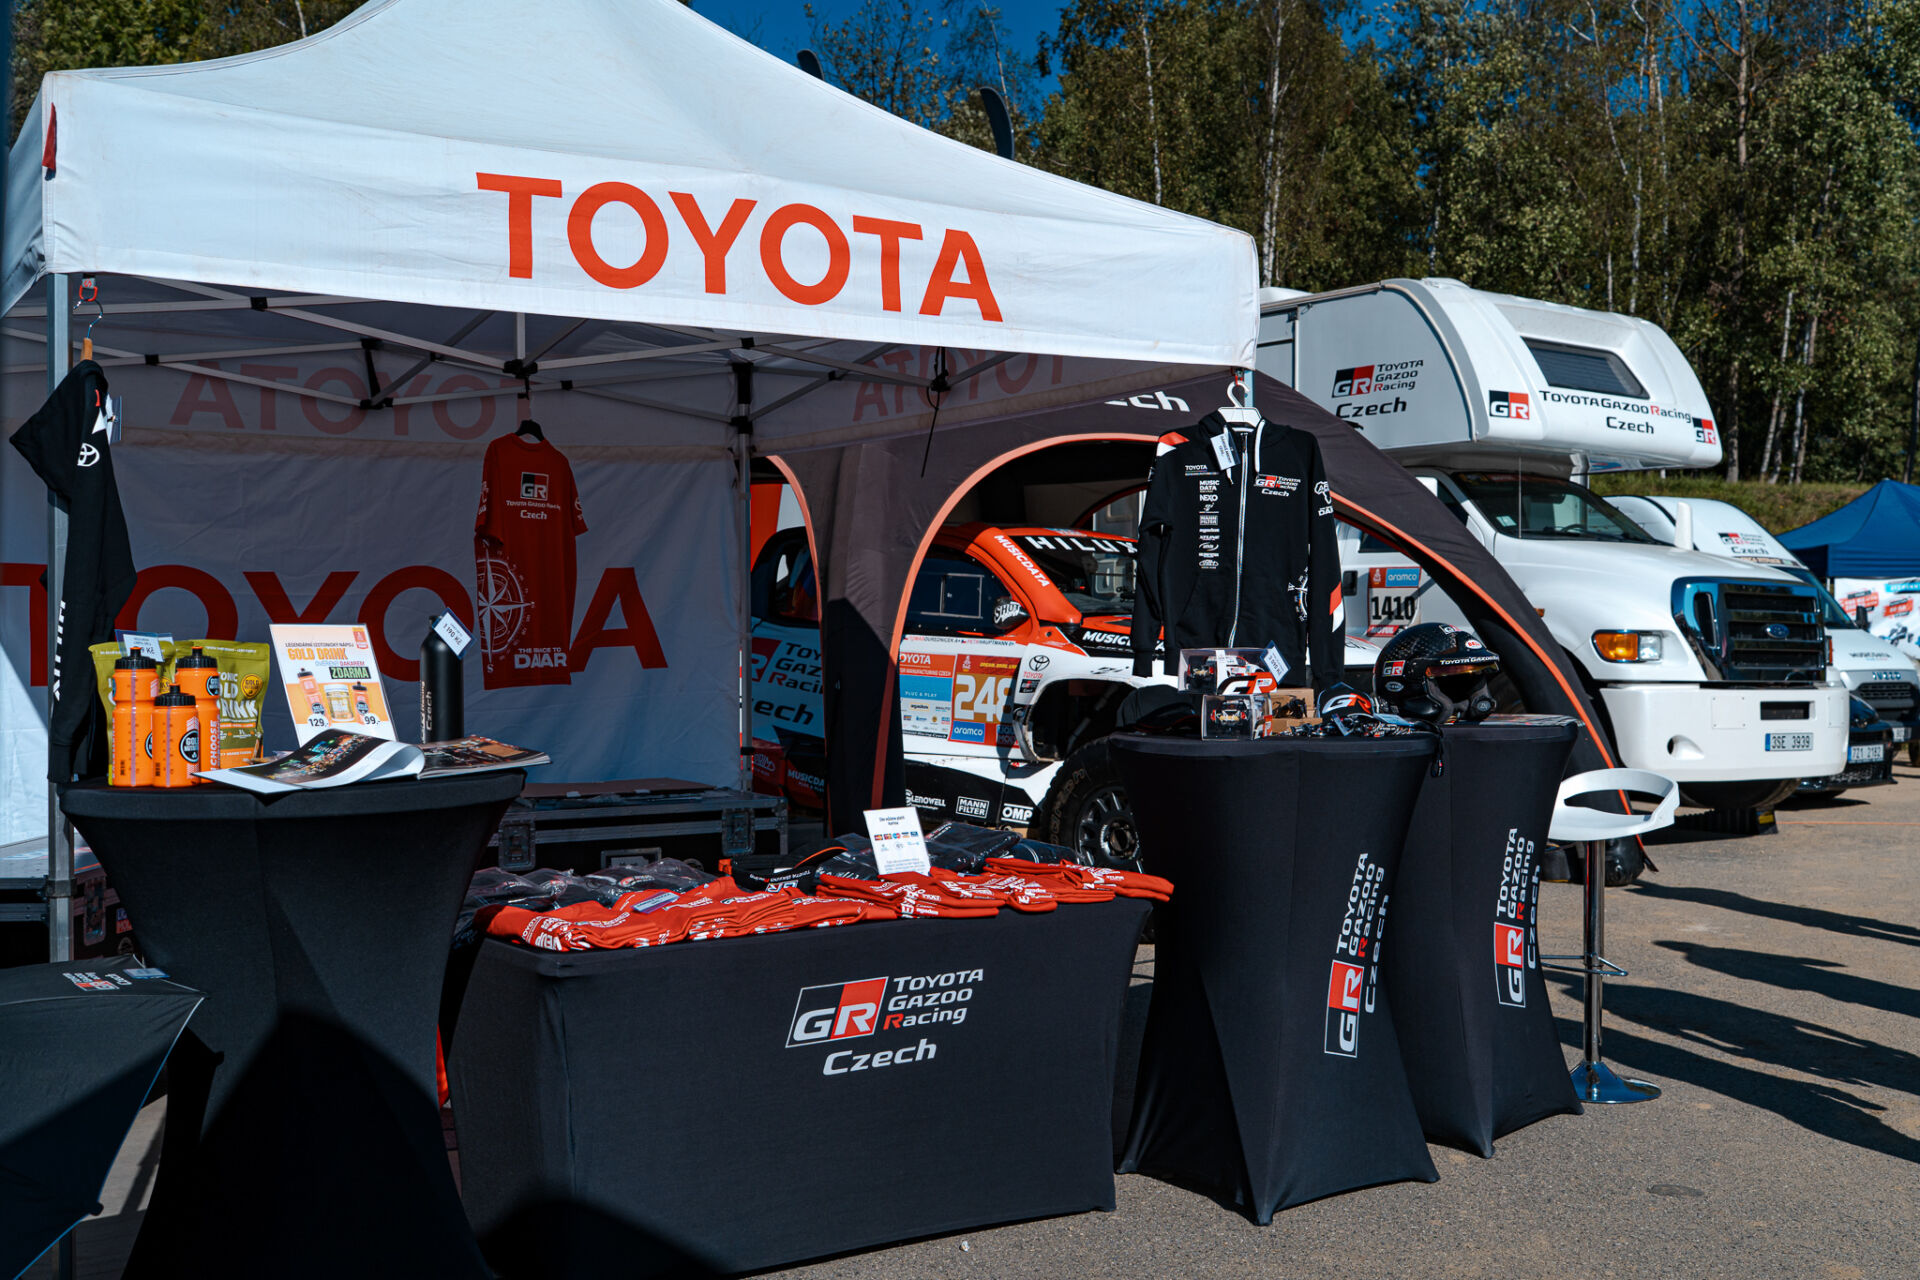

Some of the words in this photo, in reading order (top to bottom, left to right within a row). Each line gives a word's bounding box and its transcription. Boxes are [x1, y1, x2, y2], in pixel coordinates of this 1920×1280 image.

[476, 172, 1003, 322] TOYOTA
[1375, 370, 1418, 382] GAZOO
[1377, 360, 1424, 372] TOYOTA
[1332, 378, 1371, 397] GR
[1374, 381, 1416, 392] Racing
[1336, 397, 1407, 418] Czech
[1490, 401, 1529, 420] GR
[1539, 390, 1600, 407] TOYOTA
[1601, 398, 1649, 414] GAZOO
[1650, 405, 1692, 423] Racing
[1606, 416, 1654, 434] Czech
[522, 483, 547, 499] GR
[1256, 479, 1275, 487] GR
[1262, 488, 1290, 497] Czech
[520, 509, 547, 520] Czech
[1024, 535, 1138, 554] HILUX
[994, 534, 1050, 588] MUSICDATA
[1388, 573, 1417, 582] aramco
[1371, 595, 1416, 620] 1410
[0, 562, 668, 689] TOYOA
[287, 648, 315, 661] GOLD
[317, 648, 348, 661] DRINK
[331, 667, 370, 679] ZDARMA
[487, 664, 494, 673] S
[1024, 671, 1043, 679] TOYOTA
[1384, 667, 1402, 675] GR
[955, 674, 1012, 722] 248
[1322, 692, 1371, 714] GR
[954, 727, 983, 737] aramco
[958, 805, 986, 816] FILTER
[960, 798, 987, 809] MANN
[1002, 806, 1033, 820] OMP
[1496, 828, 1518, 917] TOYOTA
[1507, 836, 1525, 919] GAZOO
[1516, 840, 1534, 920] Racing
[1336, 852, 1369, 954] TOYOTA
[1348, 862, 1376, 956] GAZOO
[1357, 866, 1385, 958] Racing
[1527, 864, 1540, 970] Czech
[1365, 894, 1390, 1014] Czech
[1507, 929, 1524, 1003] GR
[893, 968, 984, 992] TOYOTA
[888, 988, 973, 1012] GAZOO
[1339, 968, 1363, 1053] GR
[793, 1002, 877, 1042] GR
[883, 1007, 968, 1031] Racing
[823, 1038, 937, 1076] Czech
